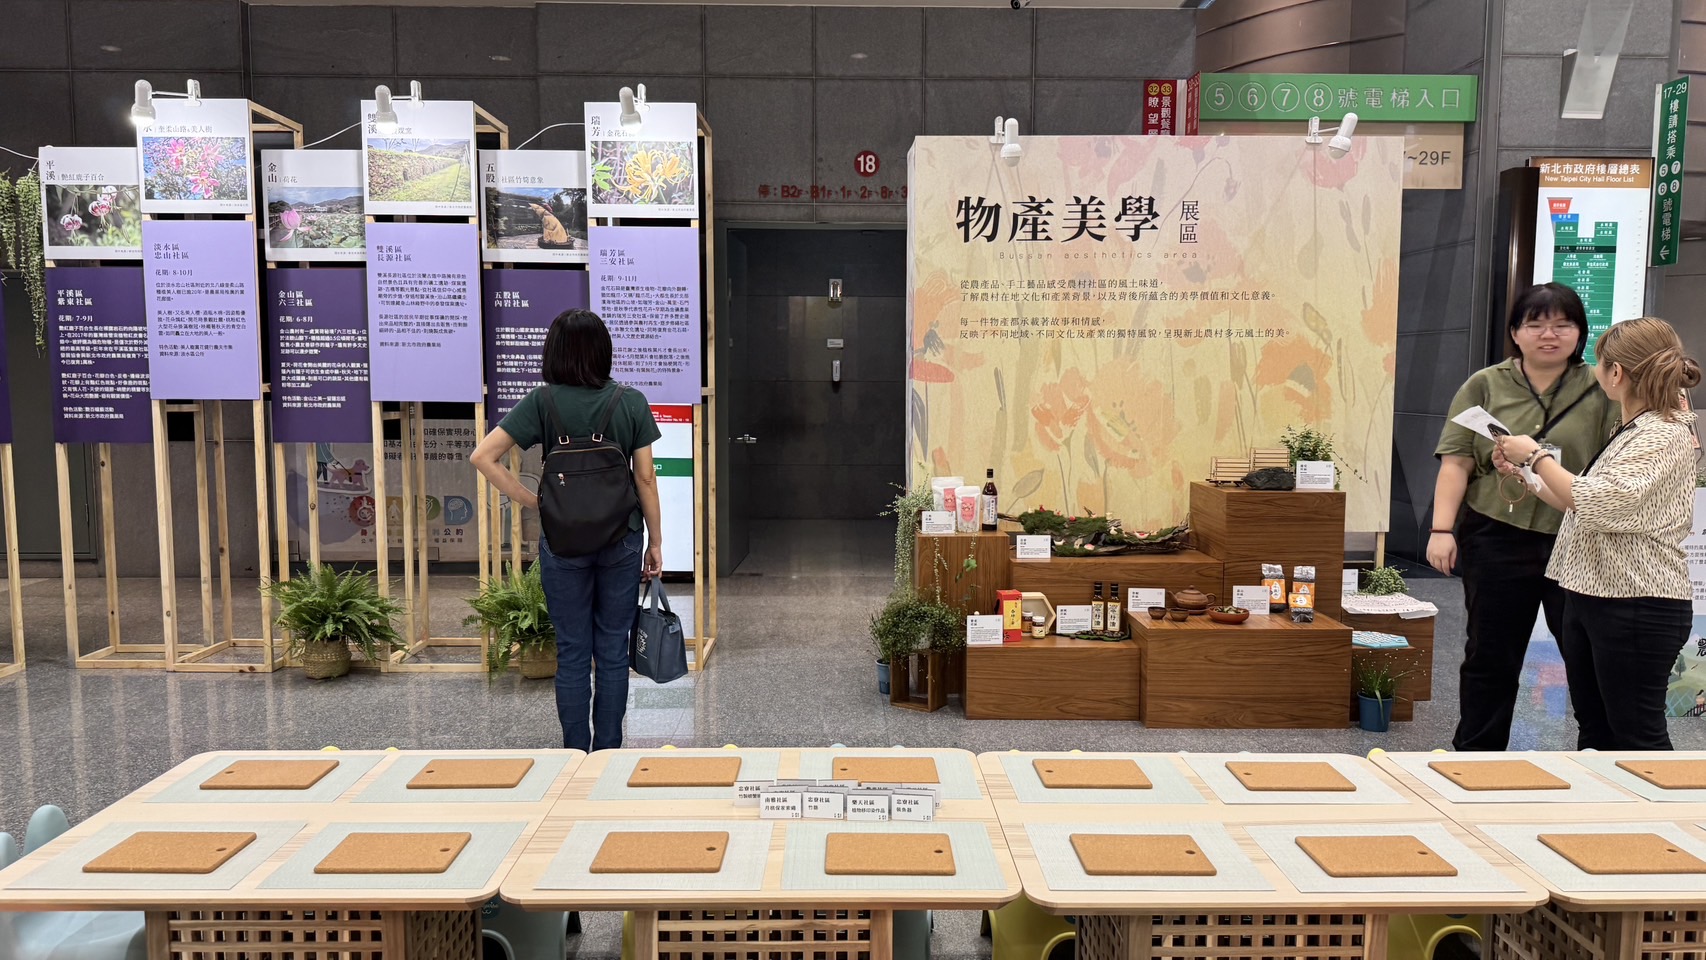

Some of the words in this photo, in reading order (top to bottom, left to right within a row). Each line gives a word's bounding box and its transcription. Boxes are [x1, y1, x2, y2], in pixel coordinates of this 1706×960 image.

[1664, 82, 1687, 99] 17-29
[591, 116, 600, 137] 瑞芳
[1666, 99, 1679, 160] 樓請搭乘
[857, 155, 876, 173] 18
[1404, 150, 1451, 165] ~29F
[46, 160, 56, 181] 平溪
[268, 162, 277, 183] 金山
[485, 163, 496, 183] 五股
[1540, 163, 1640, 175] 新北市政府樓層總表
[282, 175, 298, 184] 荷花
[956, 196, 1160, 243] 物產美學
[1179, 200, 1199, 244] 展區
[1661, 198, 1672, 240] 號電梯
[1065, 252, 1152, 260] aesthetics
[960, 279, 1163, 289] 從農產品、手工藝品感受農村社區的風土味道，
[57, 289, 83, 297] 平溪區
[960, 291, 1276, 301] 了解農村在地文化和產業背景，以及背後所蘊含的美學價值和文化意義。
[57, 298, 93, 306] 紫東社區
[278, 299, 313, 307] 六三社區
[960, 317, 1105, 327] 每一件物產都承載著故事和情感，
[959, 329, 1290, 339] 反映了不同地域、不同文化及產業的獨特風貌，呈現新北農村多元風土的美。
